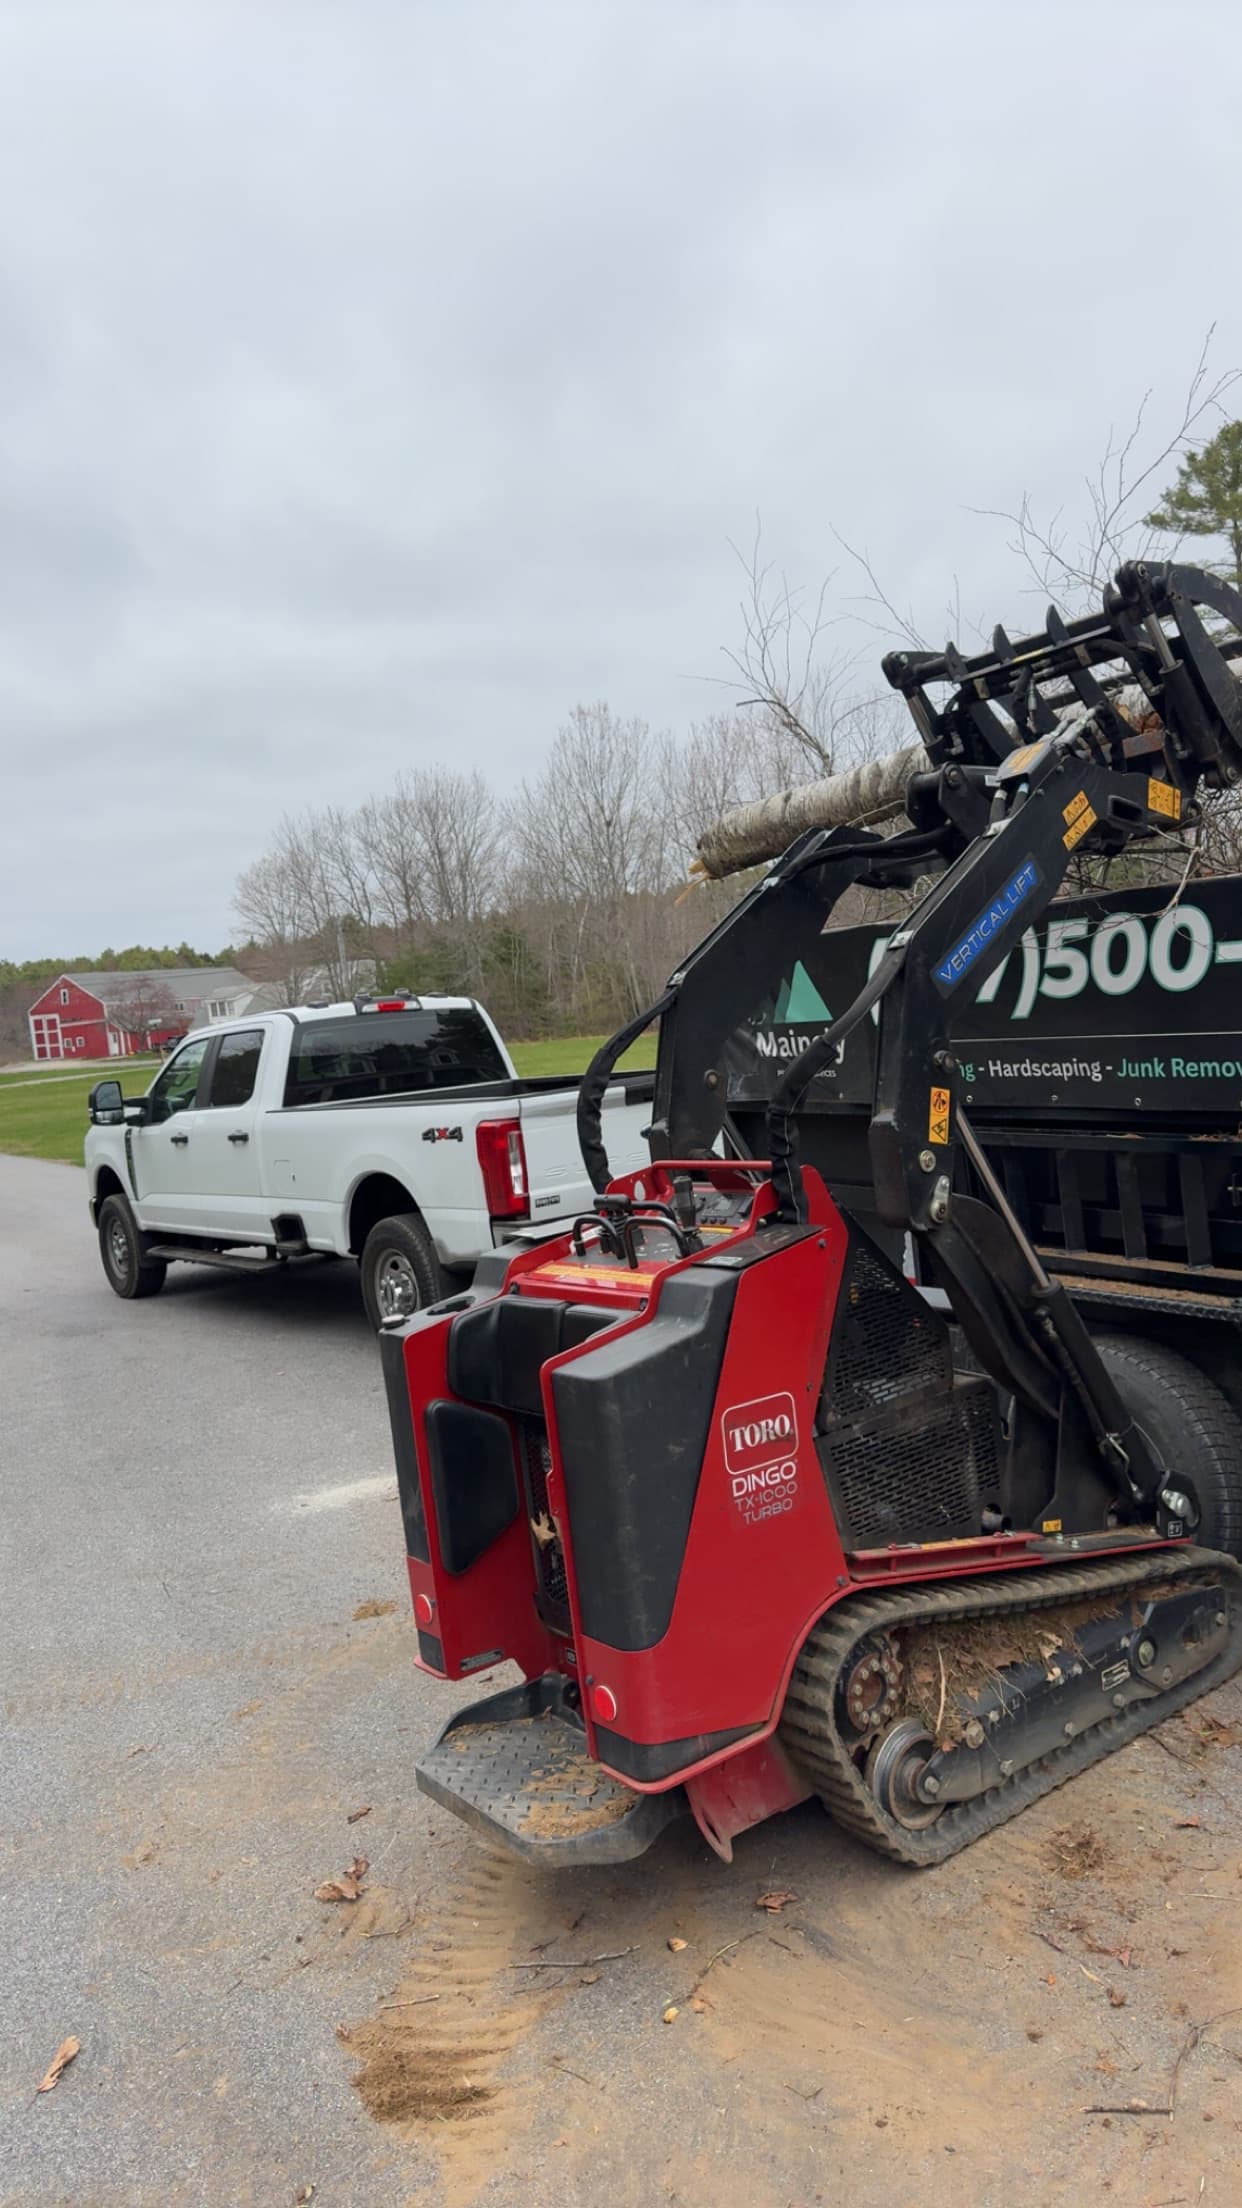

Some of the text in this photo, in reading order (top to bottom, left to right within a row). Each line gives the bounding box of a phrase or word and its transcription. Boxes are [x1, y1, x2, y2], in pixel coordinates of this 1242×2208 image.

[940, 866, 1034, 980] VERTICAL LIFT
[988, 1058, 1102, 1081] Hardscaping
[1117, 1058, 1166, 1078] Junk
[729, 1414, 791, 1453] TORO
[732, 1461, 796, 1497] DINGO
[743, 1498, 793, 1525] TURBO
